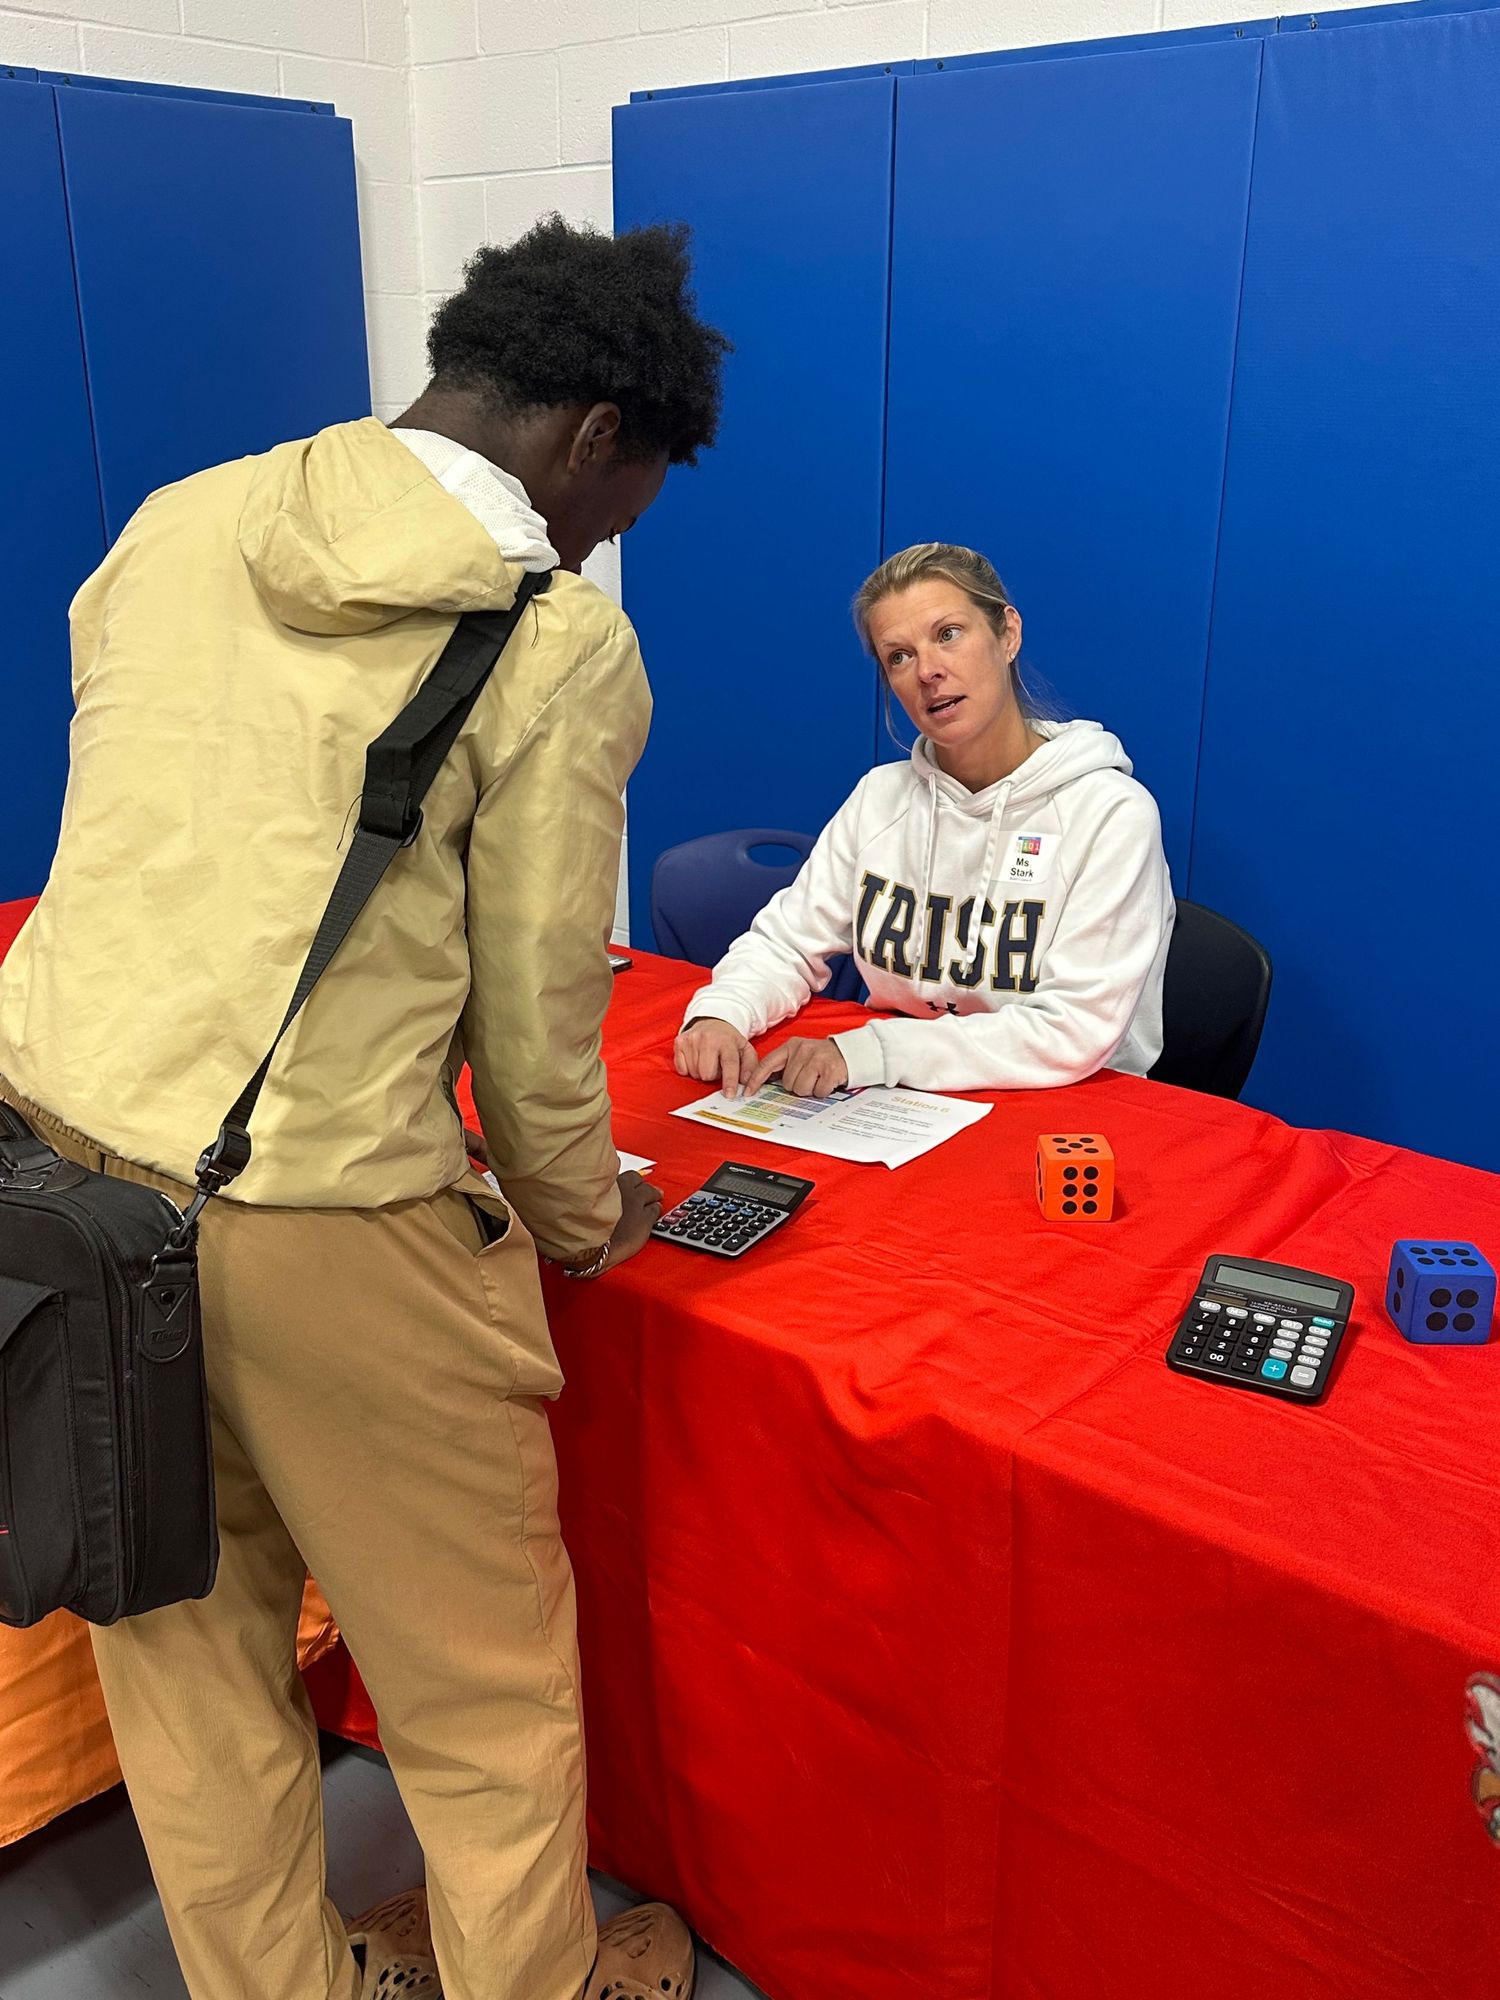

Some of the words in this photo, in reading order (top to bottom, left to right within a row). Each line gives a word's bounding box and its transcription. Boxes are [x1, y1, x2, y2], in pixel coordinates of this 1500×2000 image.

[1010, 867, 1034, 878] Stark
[857, 870, 1046, 994] IRISH
[1209, 1353, 1224, 1362] 00
